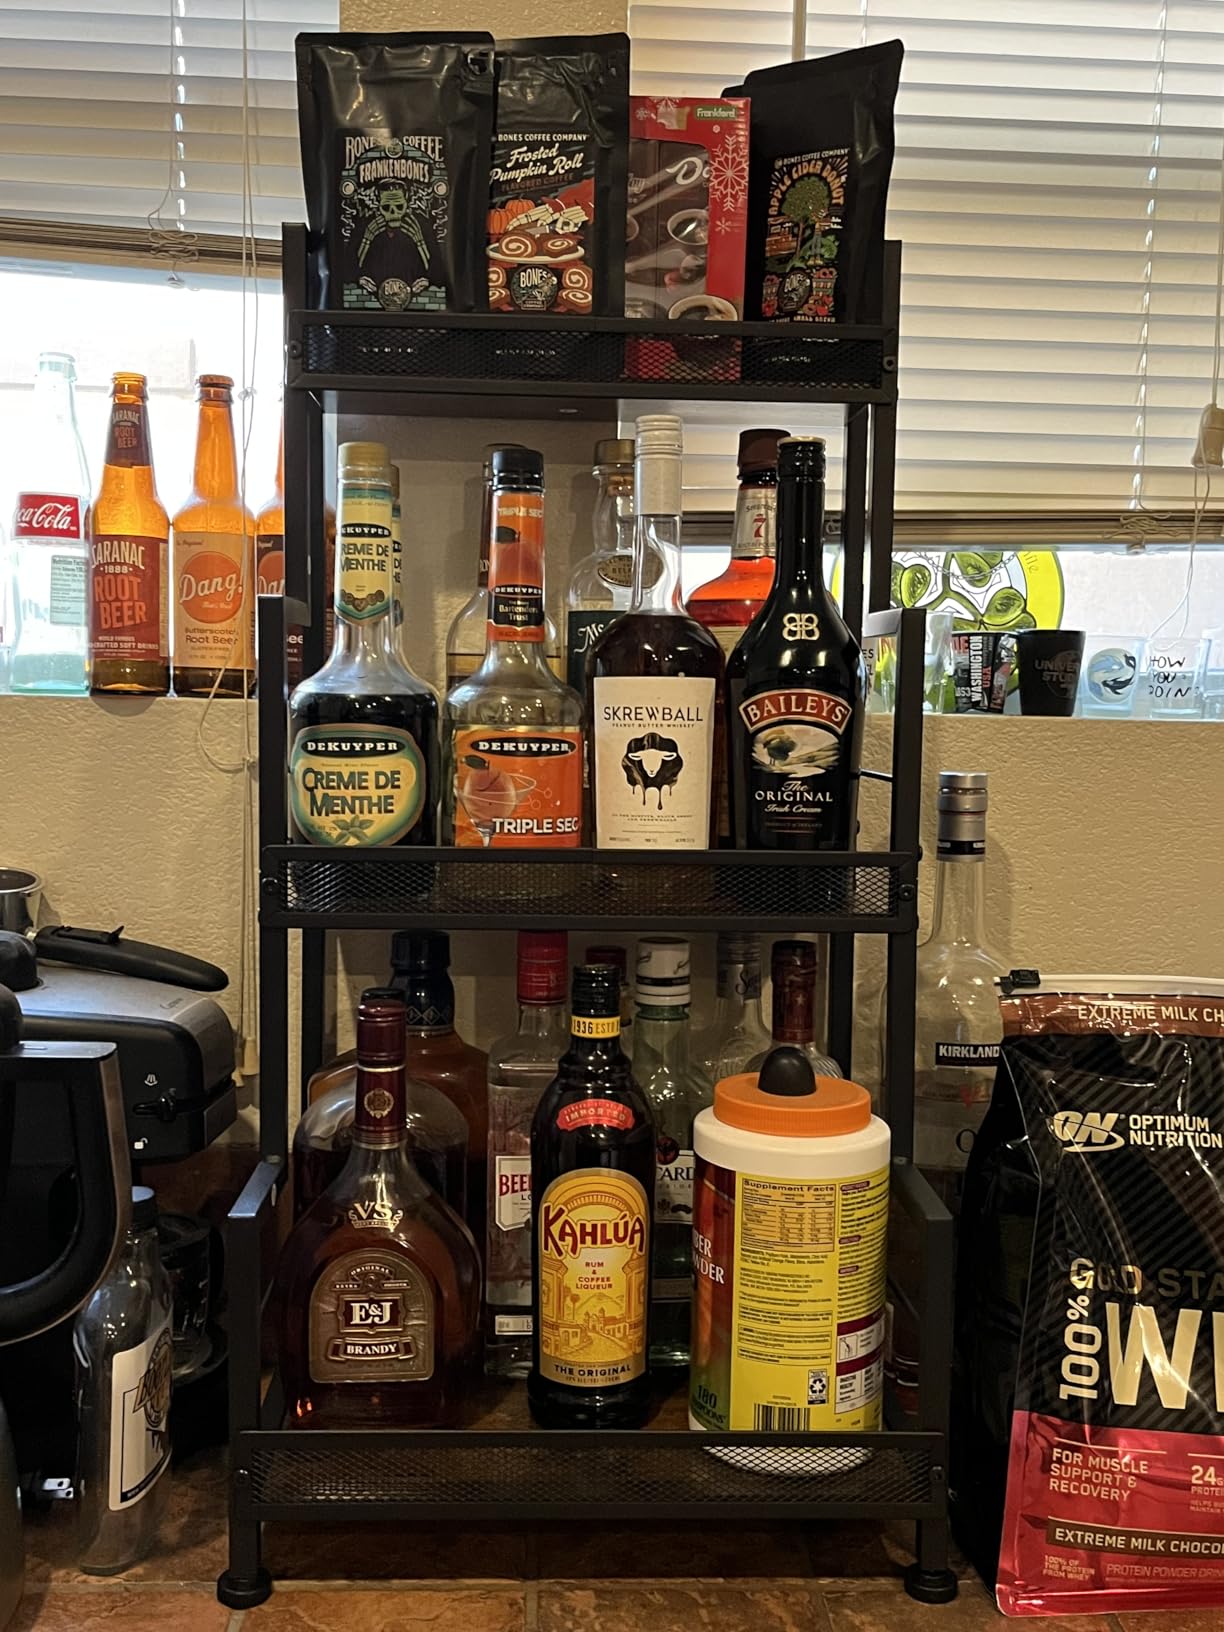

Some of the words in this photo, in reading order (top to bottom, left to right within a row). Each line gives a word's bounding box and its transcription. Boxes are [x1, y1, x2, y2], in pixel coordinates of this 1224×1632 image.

[696, 107, 736, 118] Frankford
[524, 133, 550, 141] COFFEE
[552, 133, 587, 141] COMPANY
[403, 136, 445, 161] COFFEE
[506, 143, 559, 168] Frosted
[360, 159, 429, 182] FRANKENBONES
[489, 162, 547, 184] Pumpkin
[548, 152, 584, 176] Roll
[792, 160, 823, 179] CIDER
[822, 164, 844, 205] DONUT
[520, 268, 547, 287] BONES
[528, 508, 543, 517] SEC
[752, 517, 766, 538] 7
[91, 540, 146, 570] SARANAC
[376, 544, 389, 557] DE
[94, 574, 141, 601] ROOT
[179, 573, 244, 603] Dang!
[101, 602, 147, 629] BEER
[185, 635, 210, 644] Root
[212, 636, 239, 645] Beer
[969, 634, 983, 702] WASHINGTON
[982, 666, 992, 688] USA
[1152, 671, 1177, 684] YOU
[603, 706, 703, 722] SKREWBALL
[749, 695, 848, 722] BAILEYS
[303, 767, 369, 792] CREME
[375, 769, 401, 790] DE
[781, 780, 810, 793] The
[310, 792, 395, 817] MENTHE
[755, 790, 833, 802] ORIGINAL
[764, 803, 790, 813] Irish
[793, 804, 822, 813] Cream
[492, 817, 553, 834] TRIPLE
[555, 816, 579, 833] SEC
[1078, 1006, 1156, 1020] EXTREME
[1161, 1006, 1198, 1022] MILK
[573, 1020, 593, 1035] 1936
[938, 1045, 1000, 1058] KIRKLAND
[565, 1107, 626, 1123] IMPORTED
[1129, 1114, 1209, 1132] OPTIMUM
[1129, 1131, 1223, 1148] NUTRITION
[744, 1180, 803, 1192] Supplement
[542, 1203, 646, 1258] KAHLÚA
[350, 1265, 390, 1275] ORIGINAL
[1157, 1267, 1224, 1300] STA
[350, 1302, 393, 1325] E&J
[346, 1344, 397, 1355] BRANDY
[1060, 1295, 1102, 1400] 100%
[554, 1364, 574, 1375] THE
[578, 1365, 631, 1377] ORIGINAL
[698, 1384, 717, 1409] 180
[1052, 1448, 1082, 1466] FOR
[1088, 1455, 1149, 1474] MUSCLE
[1050, 1464, 1122, 1487] SUPPORT
[1127, 1476, 1137, 1488] &
[1049, 1478, 1131, 1502] RECOVERY
[1191, 1486, 1224, 1498] PROTEI
[1055, 1528, 1127, 1548] EXTREME
[1130, 1537, 1166, 1551] MILK
[1043, 1569, 1066, 1578] FROM
[1067, 1572, 1091, 1581] WHEY
[1061, 1565, 1096, 1575] PROTEIN
[1106, 1564, 1151, 1577] PROTEIN
[1152, 1567, 1198, 1579] POWDER
